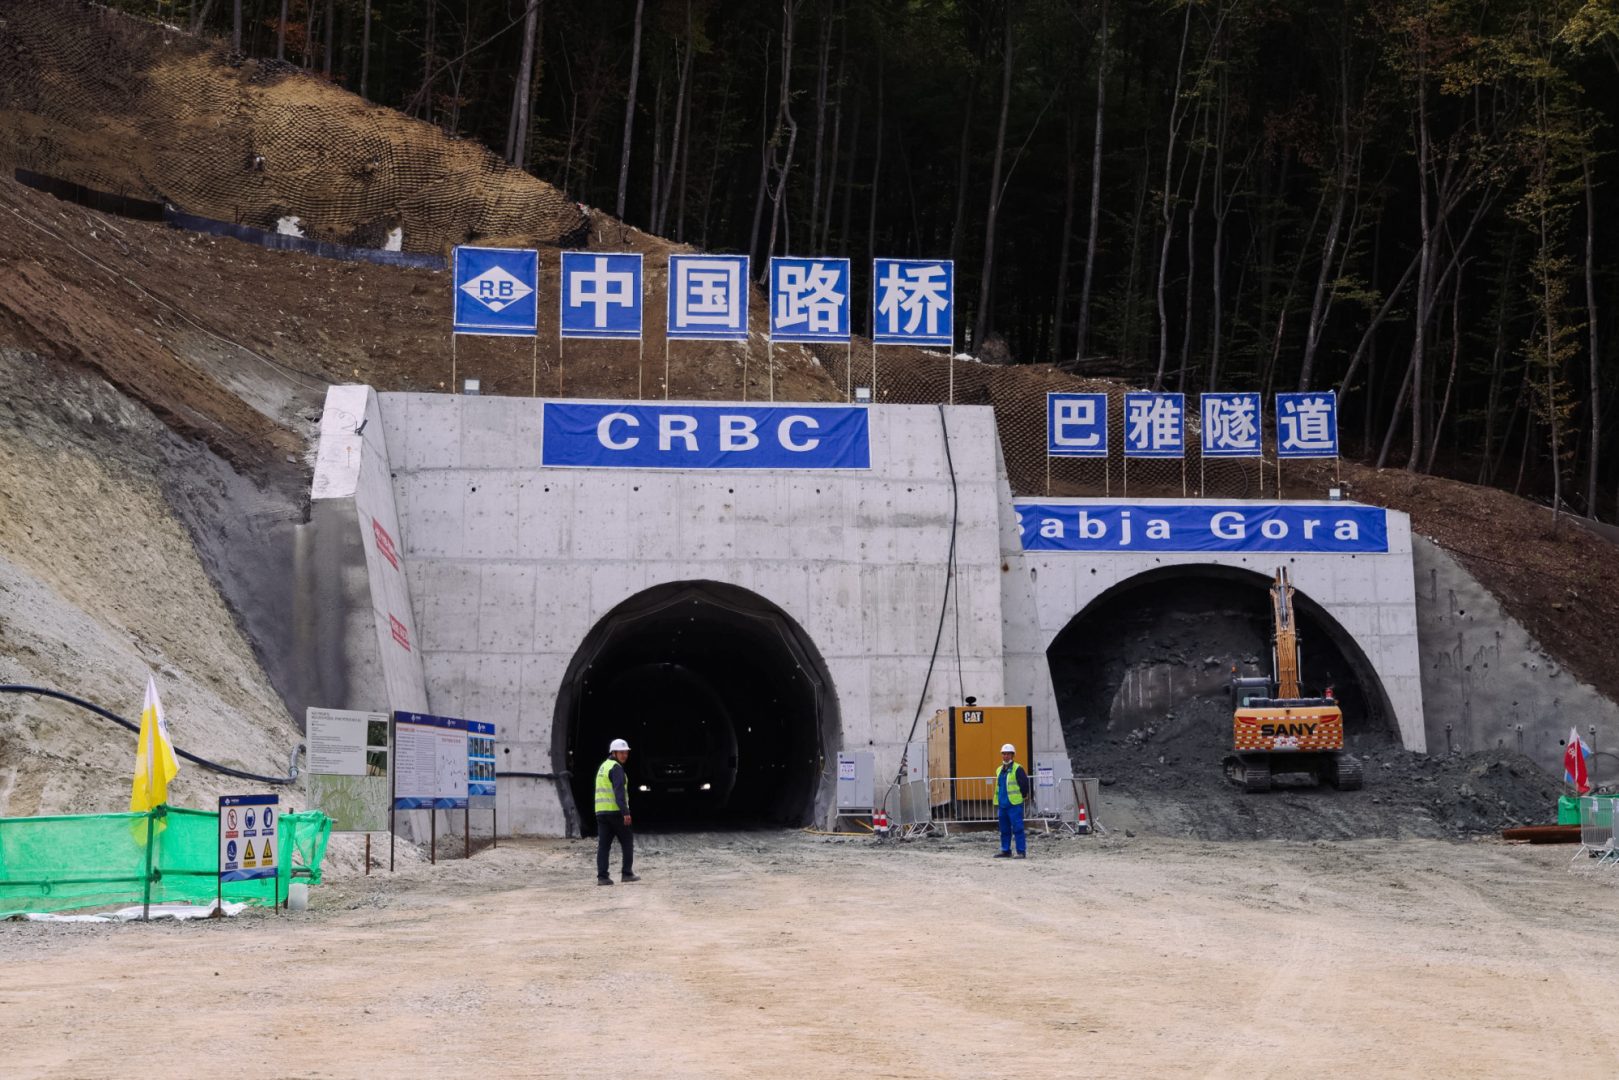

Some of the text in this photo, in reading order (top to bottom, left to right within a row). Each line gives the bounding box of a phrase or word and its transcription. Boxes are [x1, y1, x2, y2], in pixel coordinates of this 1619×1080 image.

[480, 280, 514, 297] RB
[570, 256, 949, 334] 中国路桥
[596, 412, 821, 452] CRBC
[1053, 397, 1335, 450] 巴雅隧道
[1210, 510, 1361, 541] Gora
[964, 710, 982, 723] CAT
[1260, 722, 1319, 737] SANY
